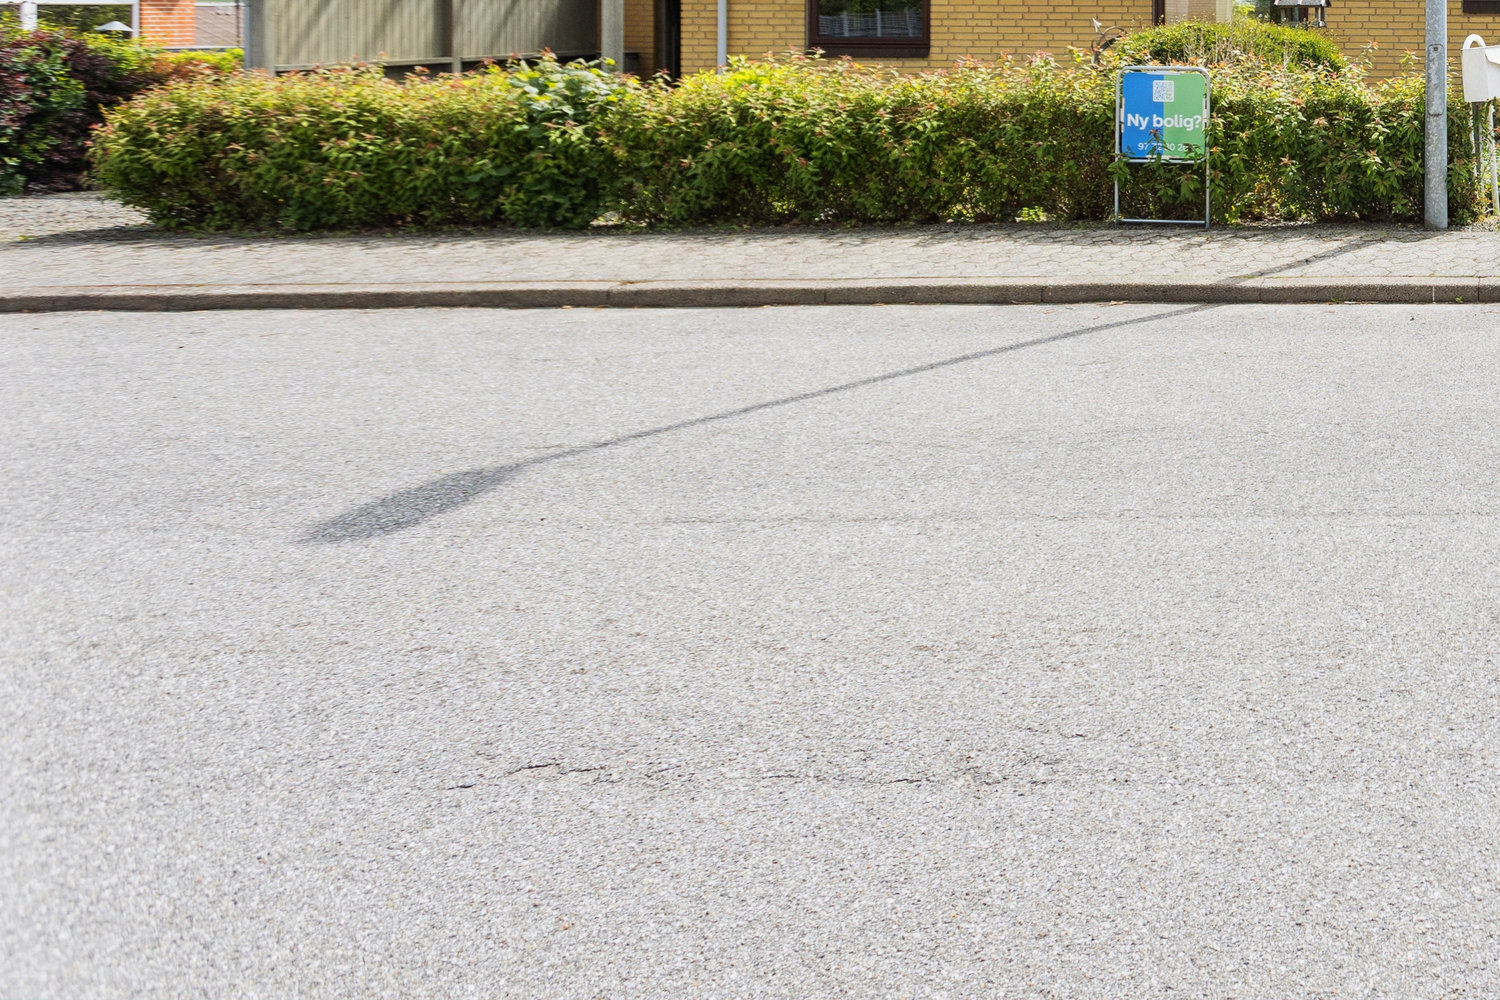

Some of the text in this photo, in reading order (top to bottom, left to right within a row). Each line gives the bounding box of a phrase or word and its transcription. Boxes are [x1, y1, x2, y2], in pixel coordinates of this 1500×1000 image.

[1127, 113, 1202, 131] Ny bolig?
[1138, 142, 1149, 151] 97
